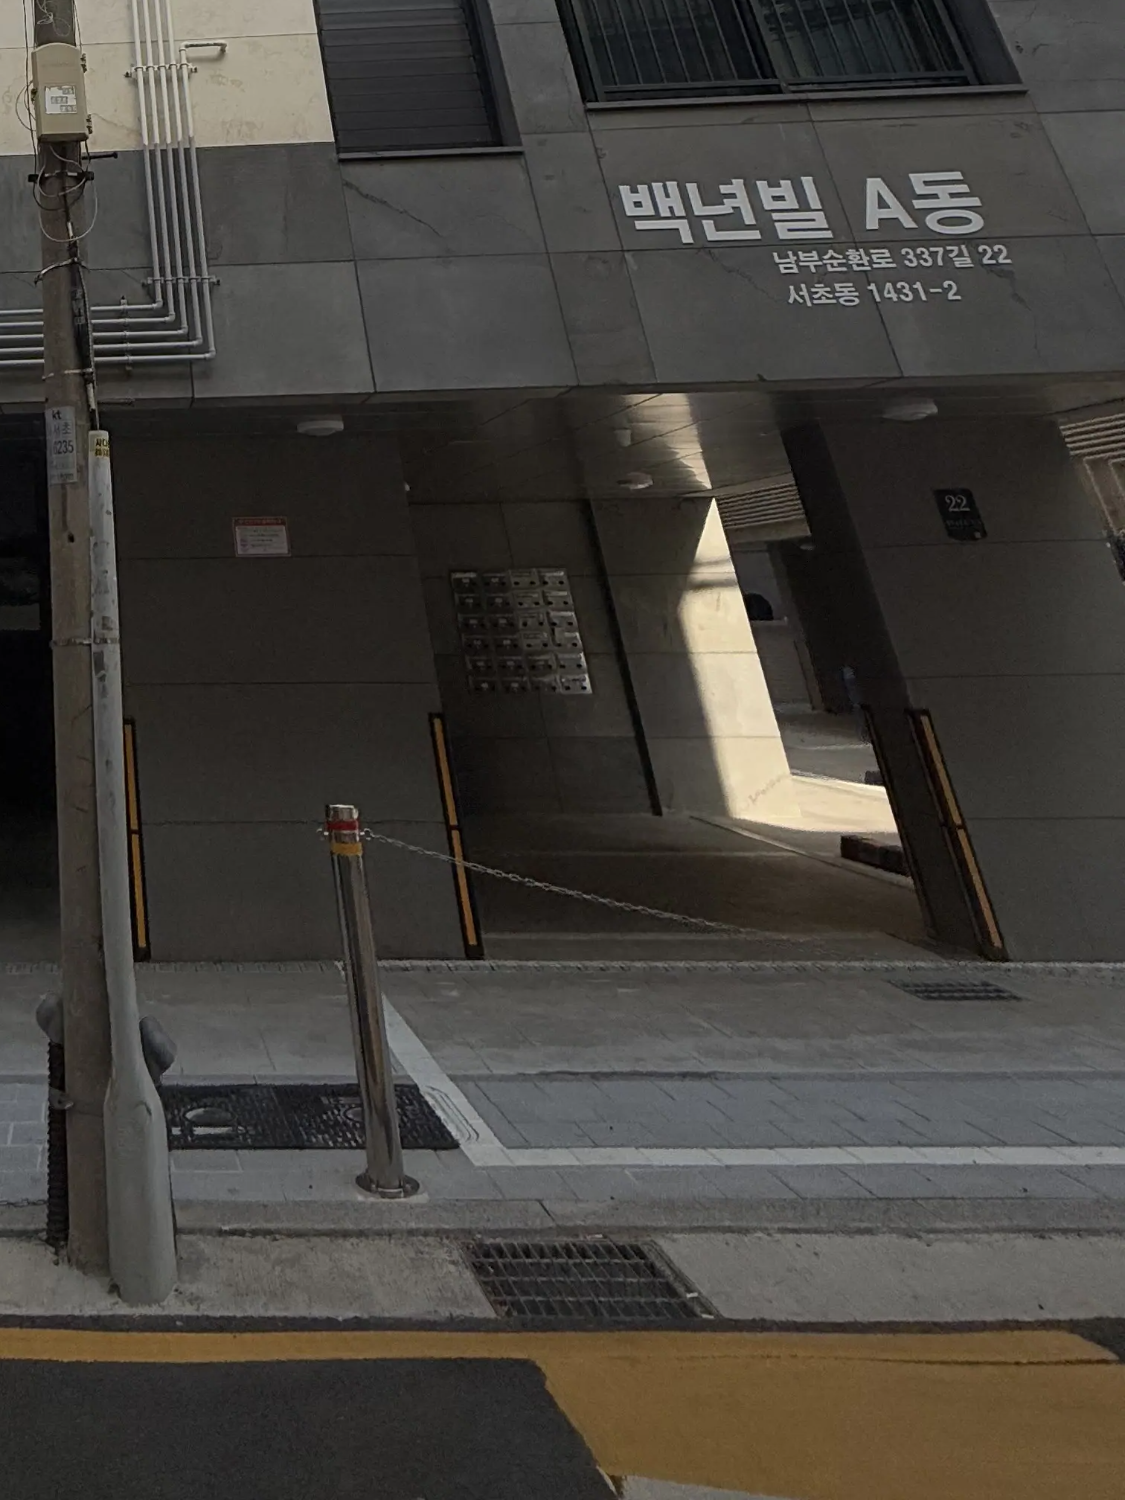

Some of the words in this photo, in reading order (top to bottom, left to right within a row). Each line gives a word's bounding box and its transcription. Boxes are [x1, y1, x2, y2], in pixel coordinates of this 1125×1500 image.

[618, 176, 834, 244] 백년빌
[865, 171, 985, 235] A동
[772, 248, 897, 274] 남부순환로
[900, 244, 975, 268] 337길
[977, 244, 1013, 265] 22
[787, 283, 860, 307] 서초동
[867, 280, 962, 302] 1431-2
[51, 409, 62, 420] kt
[944, 494, 971, 512] 22
